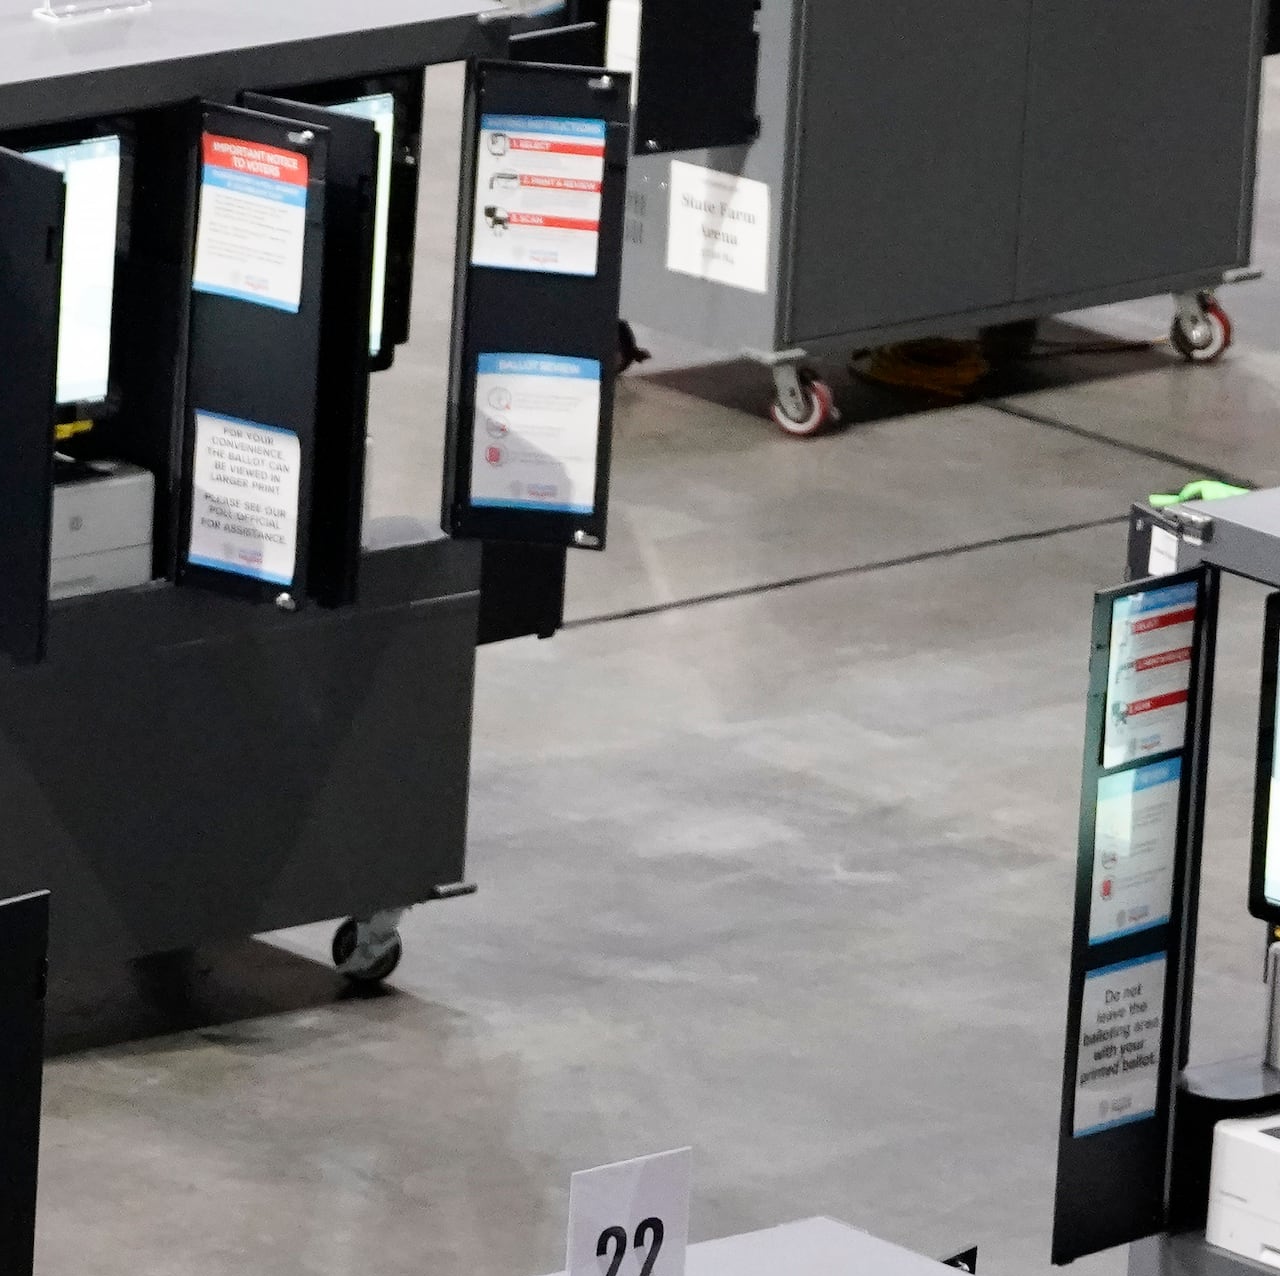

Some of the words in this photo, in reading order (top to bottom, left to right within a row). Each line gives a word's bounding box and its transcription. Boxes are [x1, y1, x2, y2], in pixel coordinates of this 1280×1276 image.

[233, 156, 245, 169] TO
[247, 161, 280, 177] VOTERS
[266, 154, 298, 169] NOTICE
[683, 195, 715, 214] State
[224, 427, 243, 438] FOR
[246, 432, 273, 445] YOUR
[207, 447, 224, 458] THE
[228, 452, 264, 467] BALLOT
[269, 462, 289, 473] CAN
[215, 461, 225, 470] BE
[231, 465, 267, 480] VIEWED
[271, 474, 280, 483] IN
[201, 518, 221, 529] FOR
